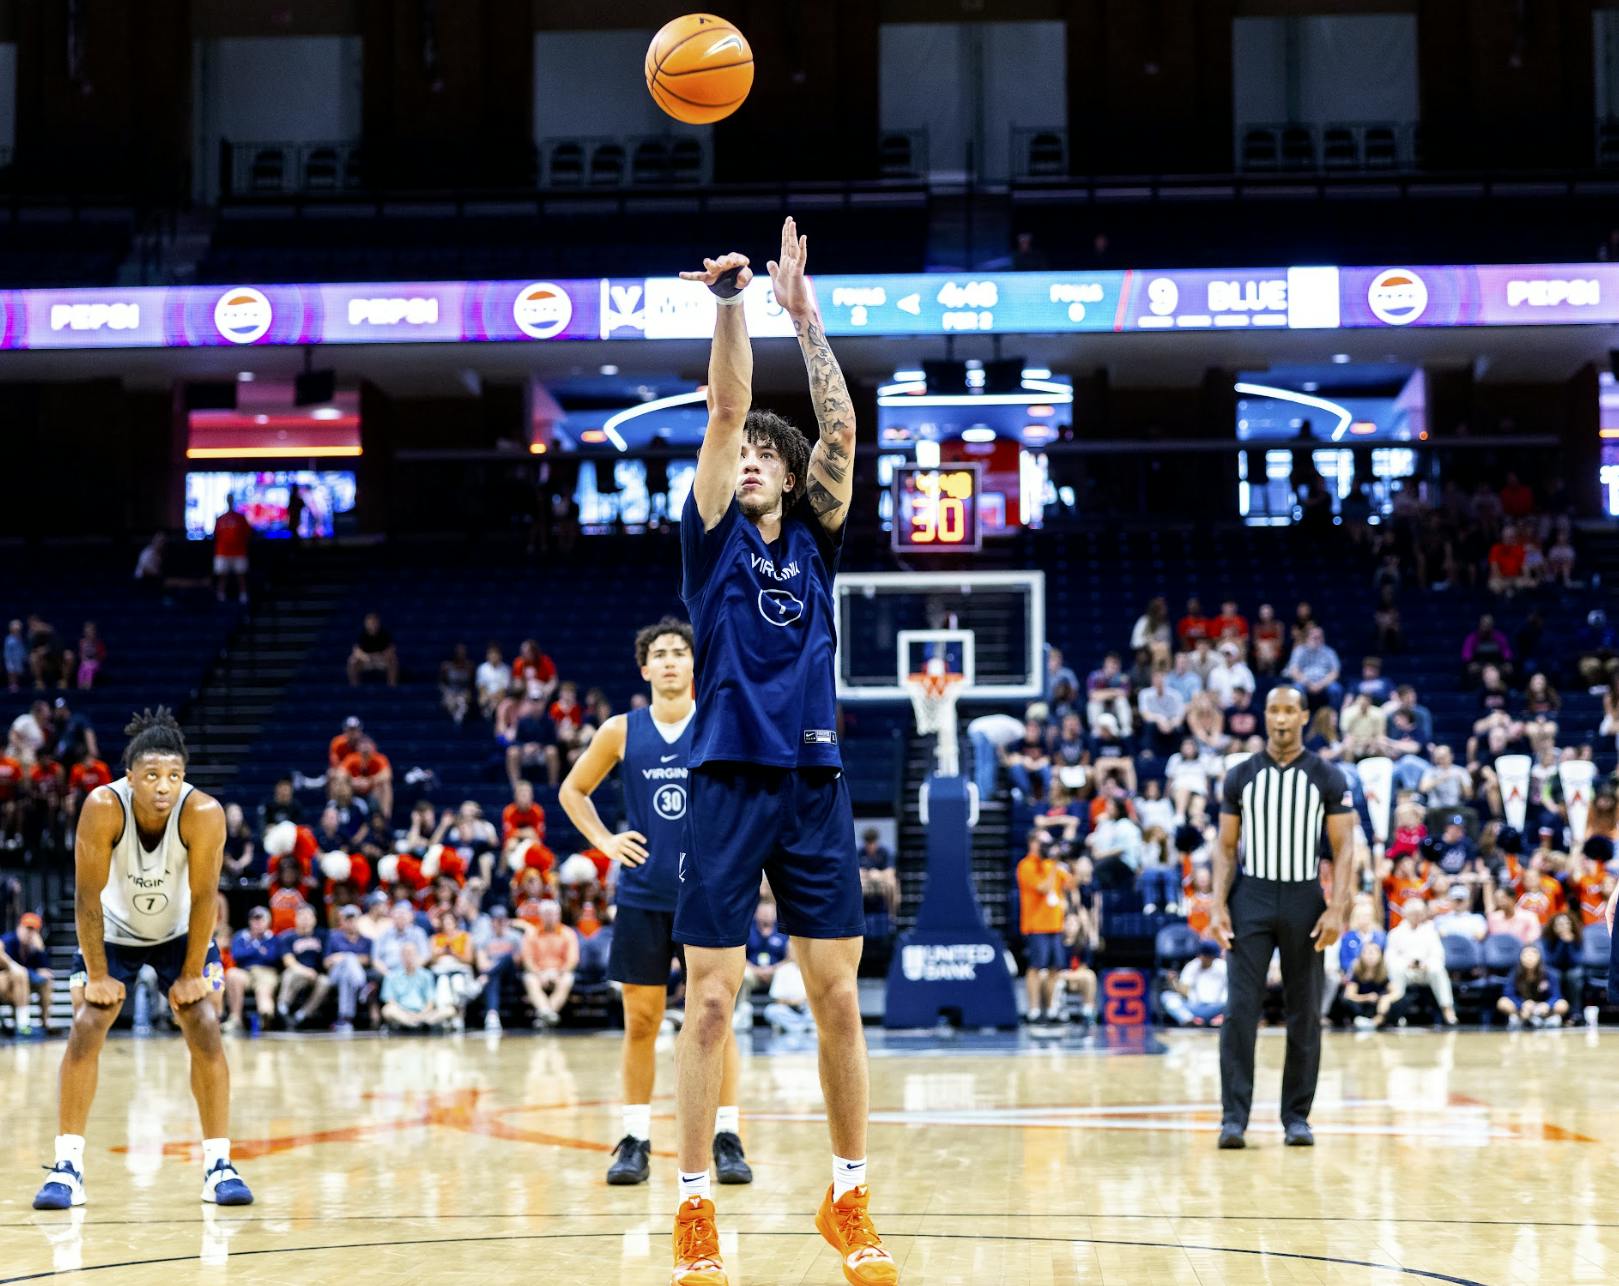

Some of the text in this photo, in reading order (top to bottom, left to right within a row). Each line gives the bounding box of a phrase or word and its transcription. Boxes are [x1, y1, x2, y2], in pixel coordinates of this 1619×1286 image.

[1148, 278, 1178, 315] 9
[1208, 281, 1287, 311] BLUE
[911, 498, 964, 542] 30
[661, 791, 681, 812] 30
[145, 897, 155, 911] 7
[1103, 971, 1145, 1025] GO
